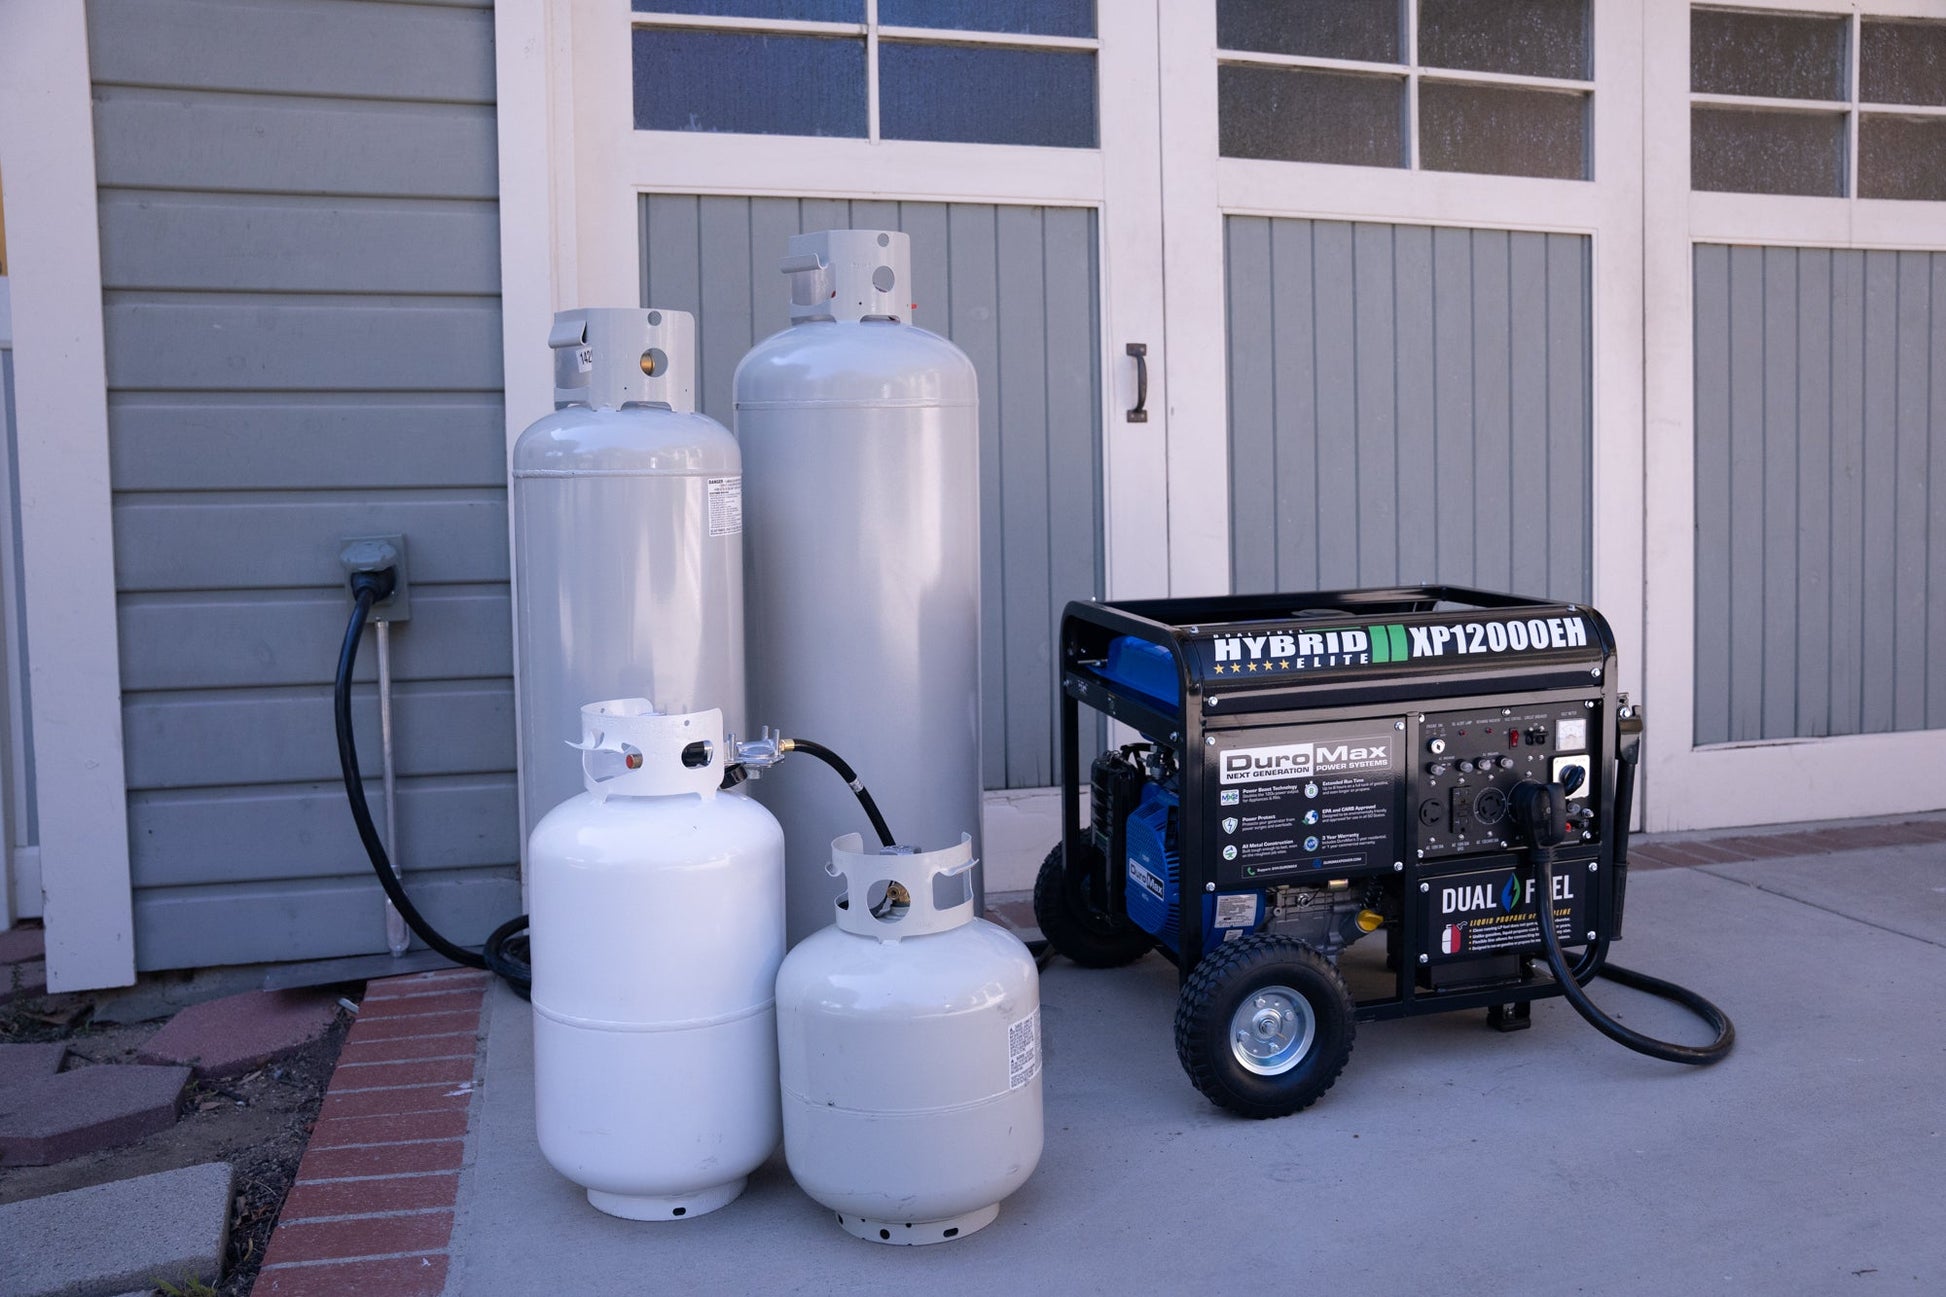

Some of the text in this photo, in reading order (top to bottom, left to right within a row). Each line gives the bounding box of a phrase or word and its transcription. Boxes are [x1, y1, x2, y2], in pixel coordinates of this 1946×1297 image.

[1214, 617, 1587, 661] HYBRID XP12000EH
[1296, 653, 1369, 669] ELITE
[1253, 767, 1310, 778] GENERATION
[1316, 759, 1388, 772] POWER SYSTEMS
[1442, 875, 1574, 914] DUAL FEL
[1470, 917, 1494, 926] LIQUID
[1495, 914, 1526, 924] PROPANE
